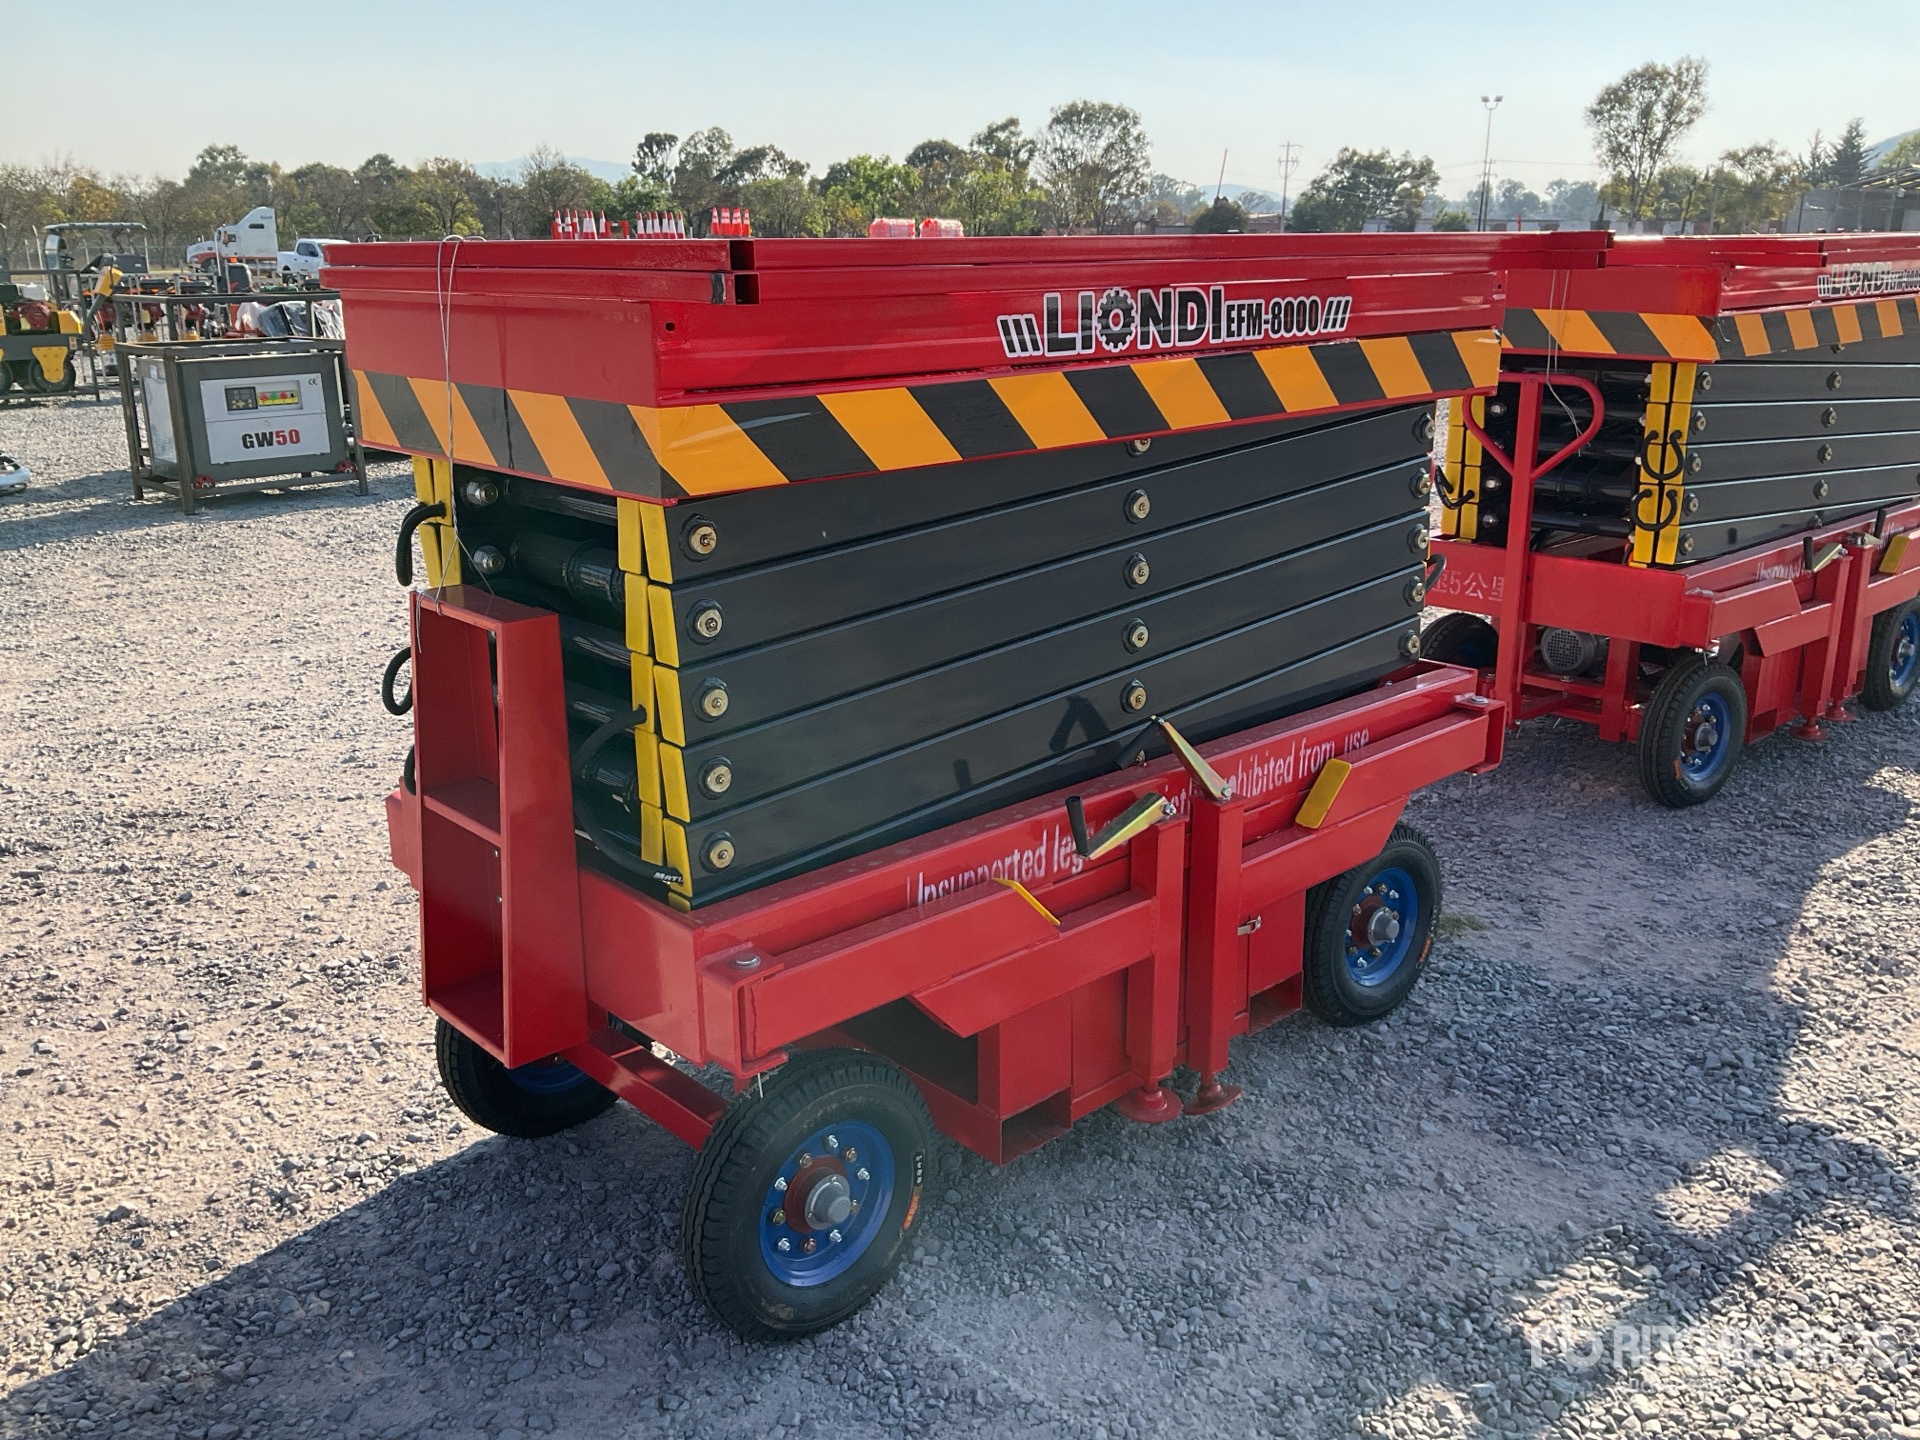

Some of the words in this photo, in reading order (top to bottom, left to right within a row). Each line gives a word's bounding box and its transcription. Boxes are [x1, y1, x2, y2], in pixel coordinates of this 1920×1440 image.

[1044, 286, 1225, 356] LIONDI
[1224, 297, 1321, 341] EFM-8000
[241, 429, 301, 449] GW50
[1052, 823, 1095, 875] leg
[1226, 740, 1295, 798] ohibited
[1298, 735, 1336, 780] from
